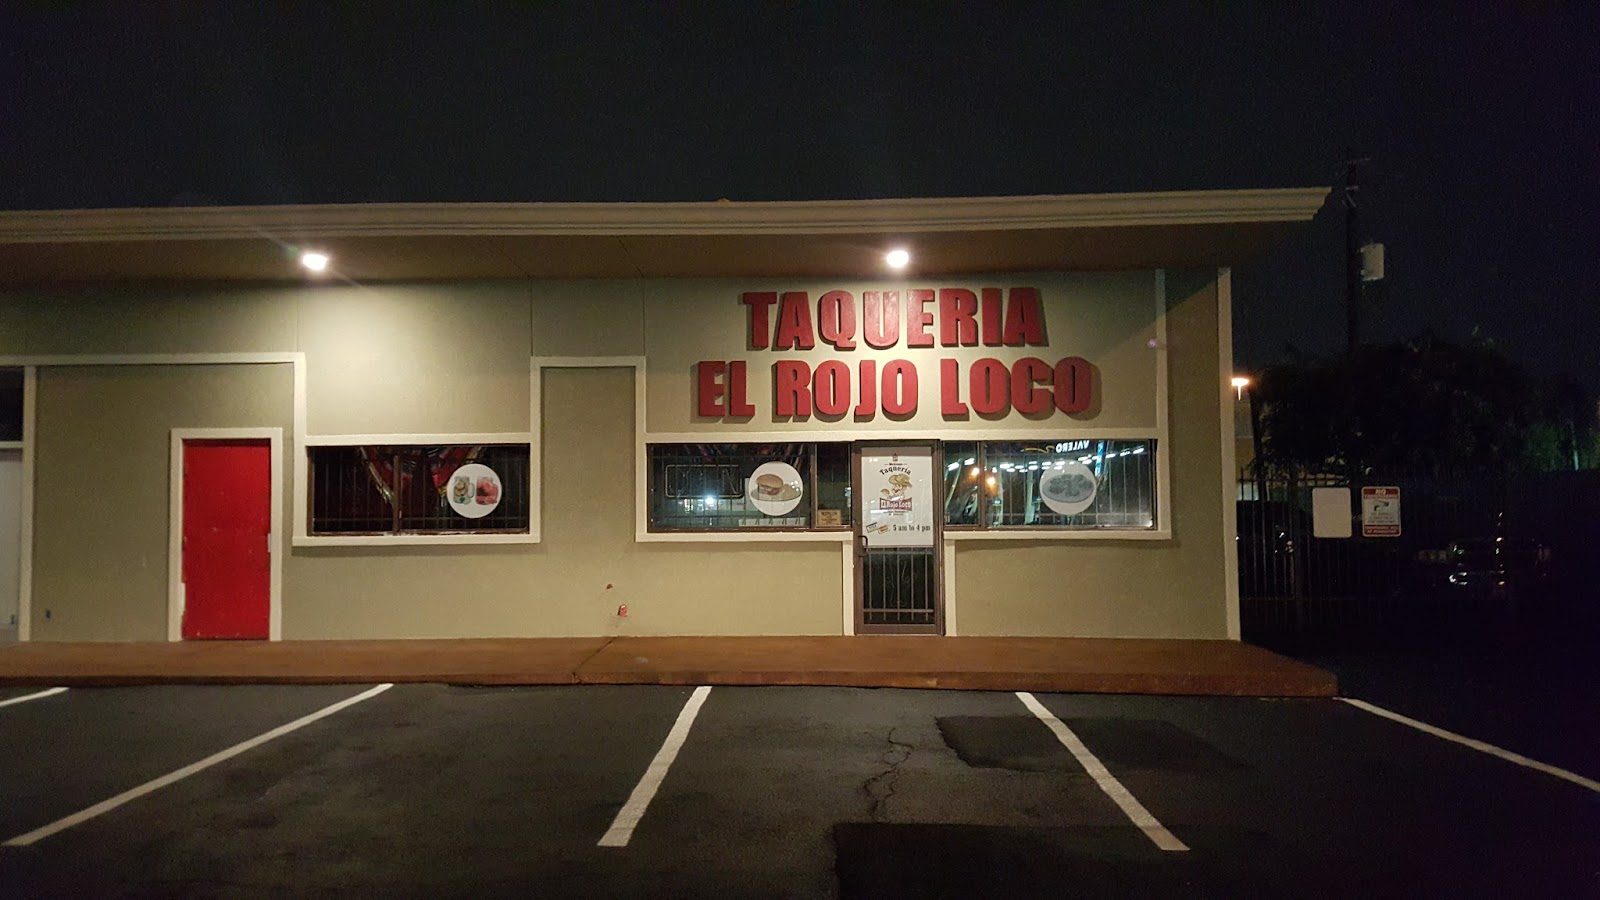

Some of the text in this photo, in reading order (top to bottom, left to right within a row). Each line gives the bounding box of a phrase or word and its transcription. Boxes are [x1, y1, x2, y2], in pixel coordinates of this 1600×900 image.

[743, 287, 1047, 351] TAQUERIA
[698, 356, 1098, 422] EL ROJO LOCO
